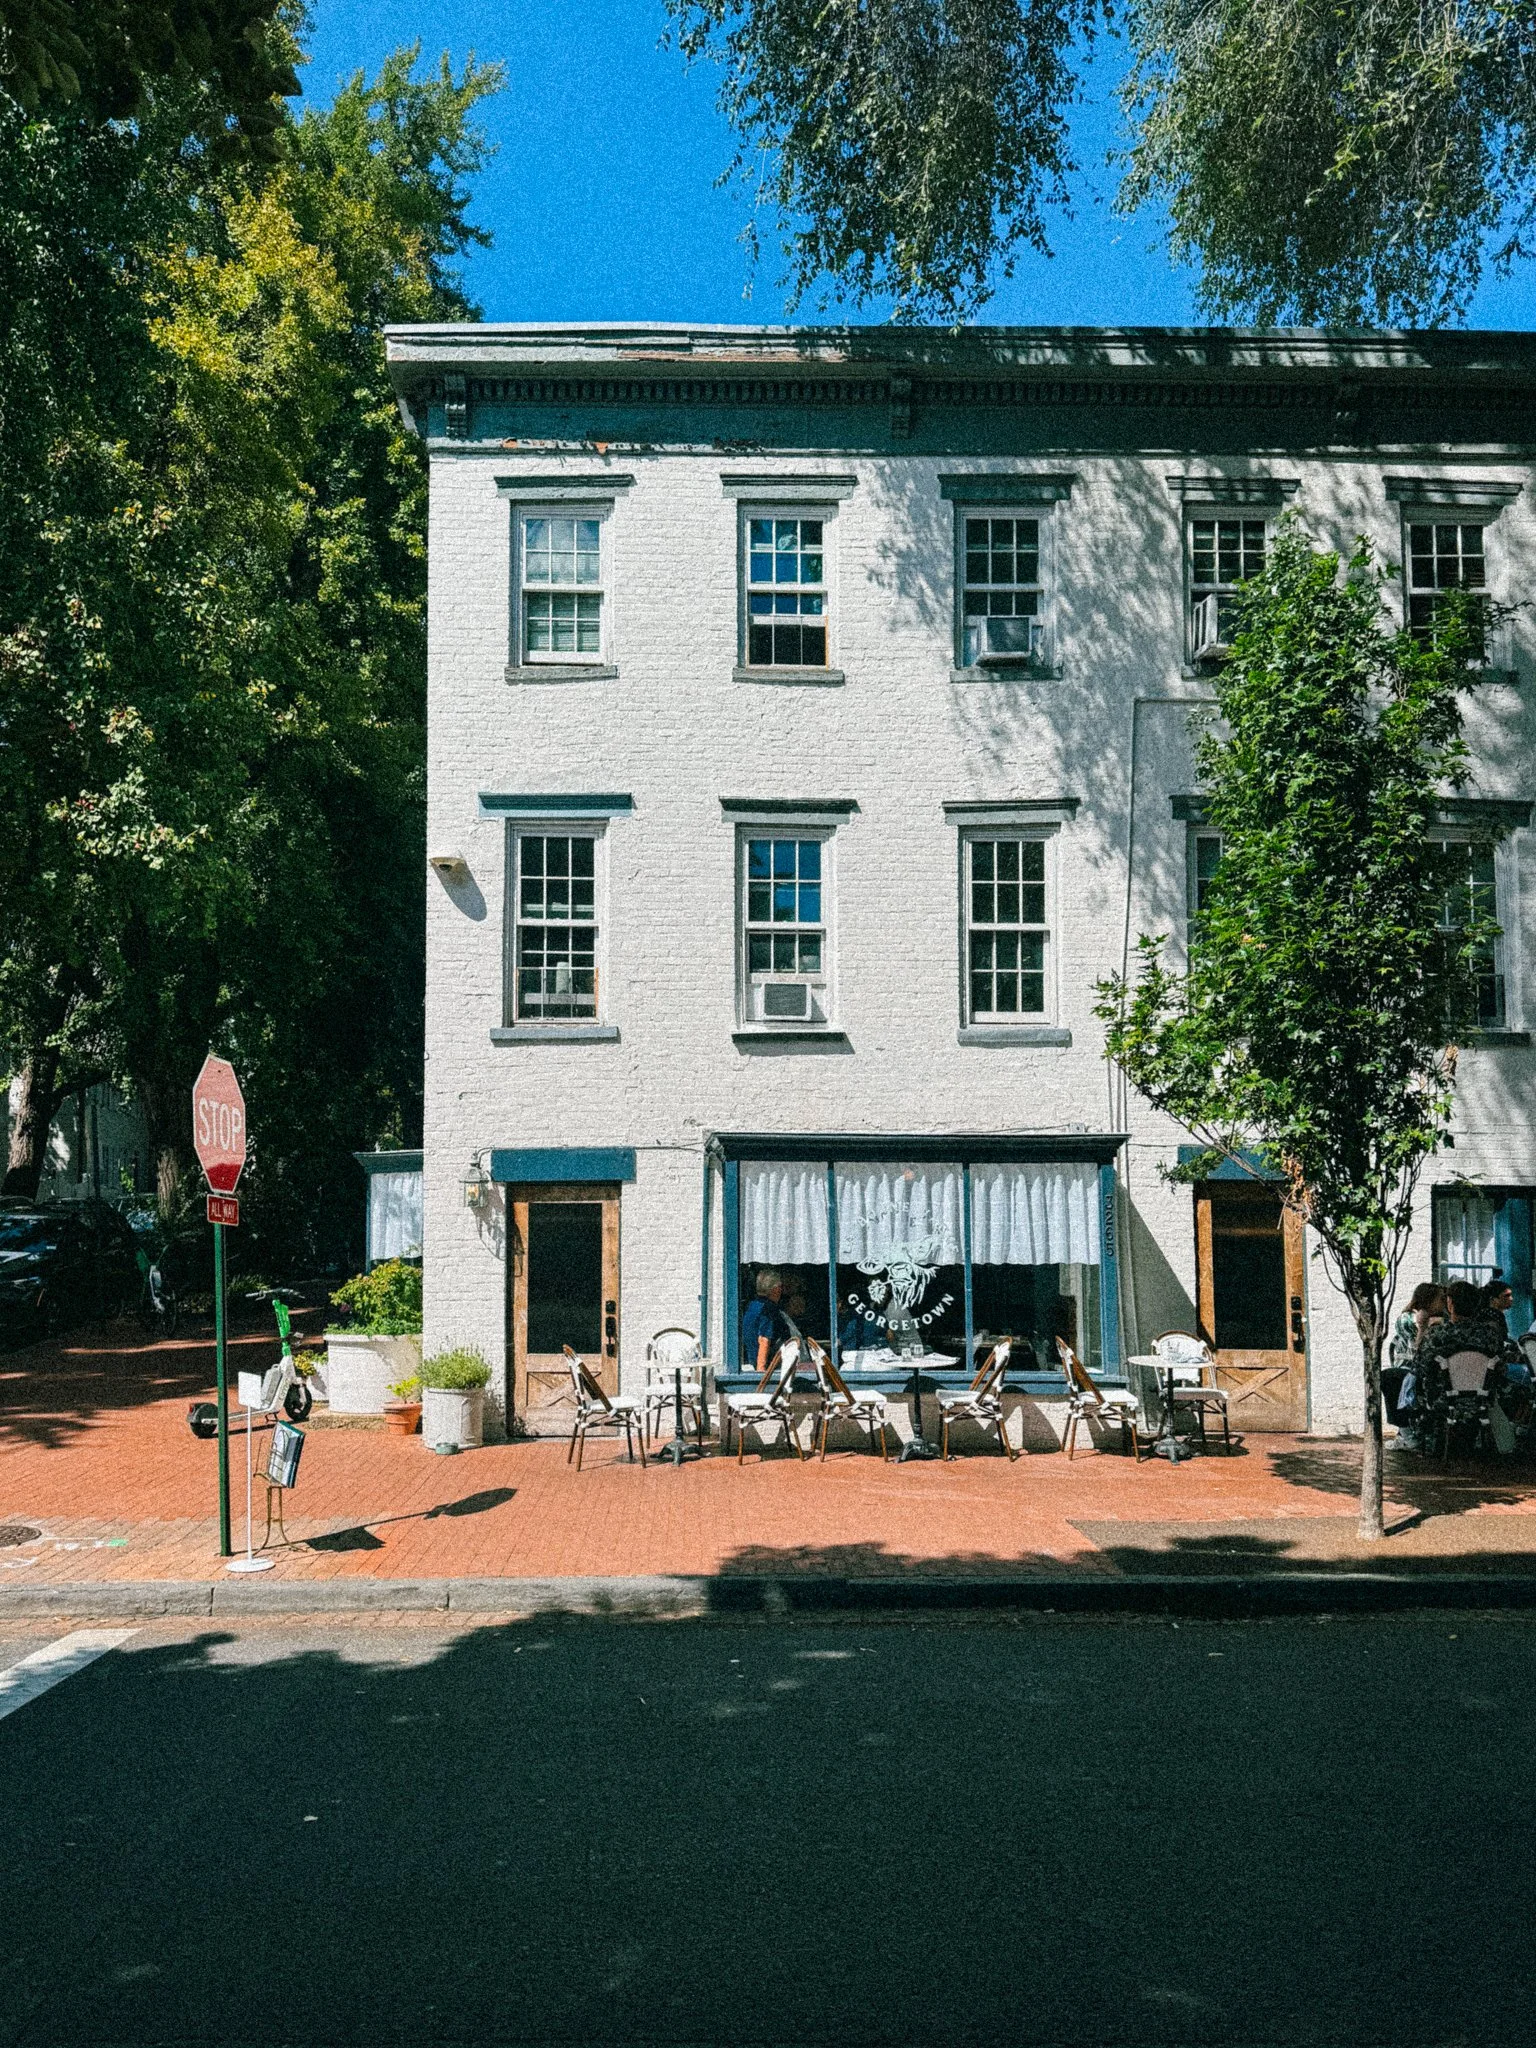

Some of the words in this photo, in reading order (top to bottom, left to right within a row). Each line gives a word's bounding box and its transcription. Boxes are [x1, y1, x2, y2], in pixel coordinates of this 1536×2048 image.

[199, 1097, 242, 1152] STOP
[211, 1201, 222, 1218] ALL
[223, 1203, 236, 1220] WAY
[1105, 1195, 1115, 1257] 3265
[847, 1293, 955, 1331] GEORGETOWN
